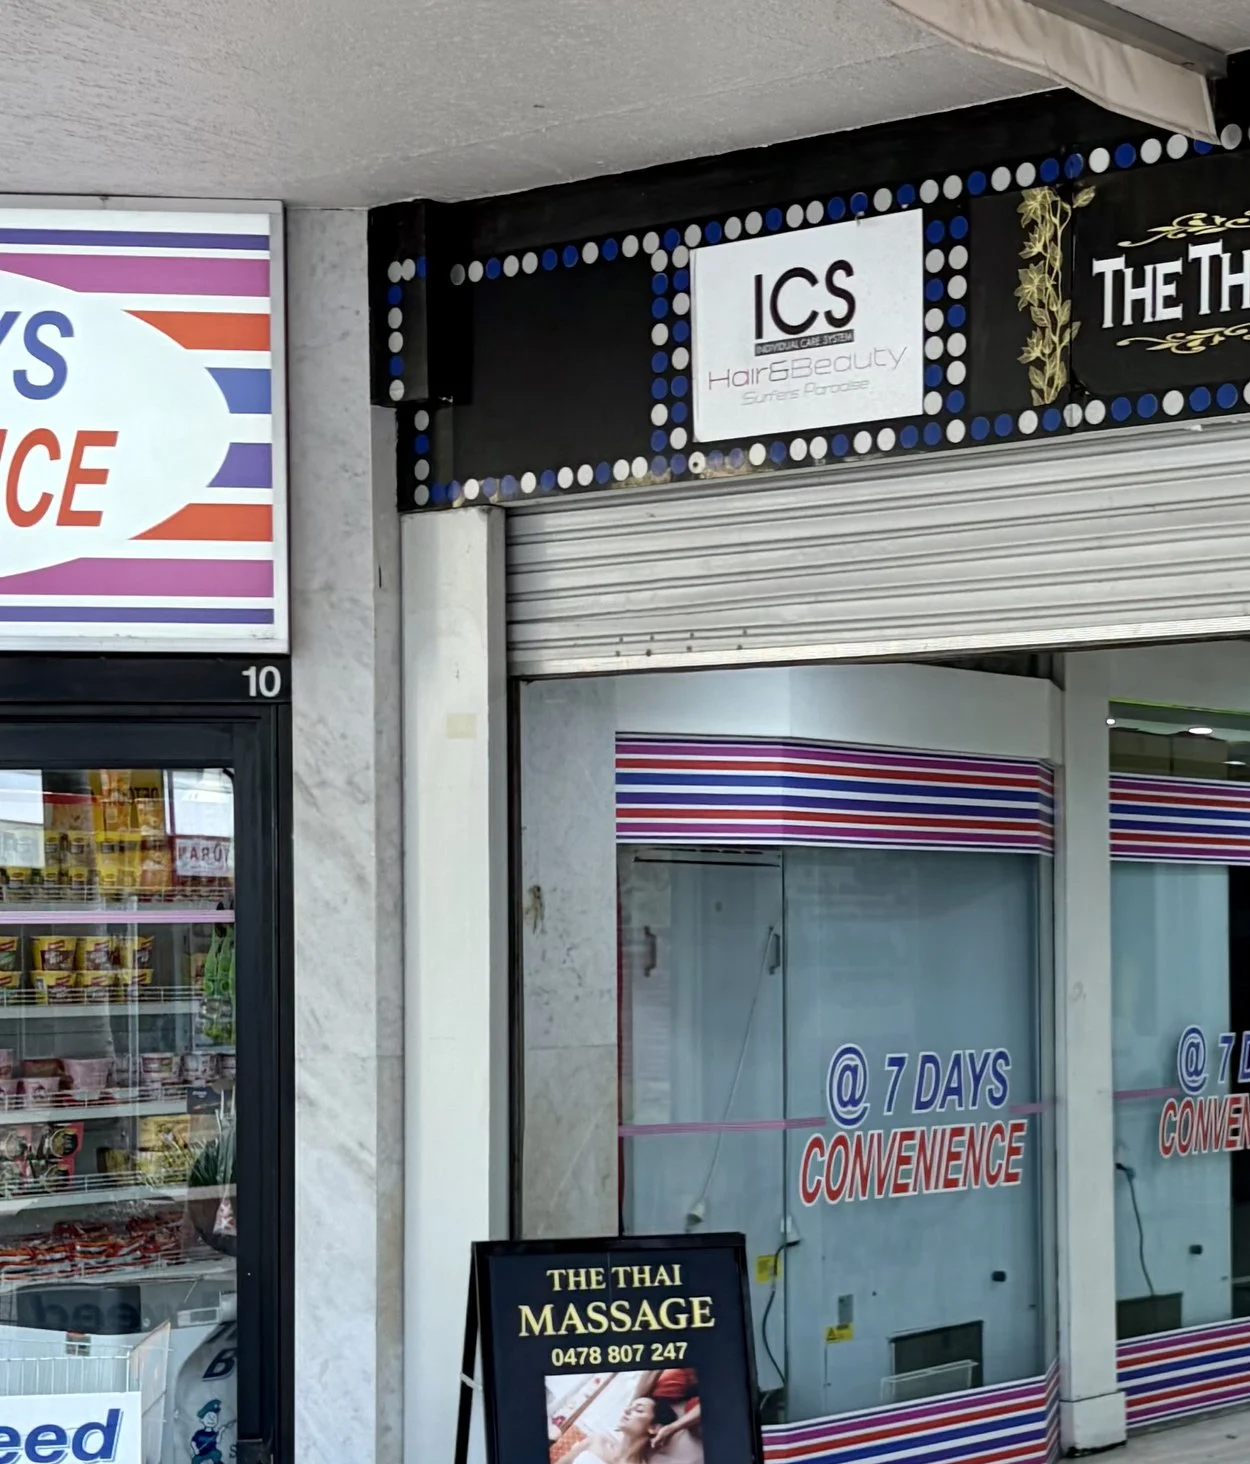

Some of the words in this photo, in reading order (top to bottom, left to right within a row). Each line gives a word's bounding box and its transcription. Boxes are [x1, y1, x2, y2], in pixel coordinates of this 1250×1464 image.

[754, 259, 856, 340] ICS
[756, 341, 798, 355] INDIVIDUAL
[800, 338, 820, 348] CARE
[823, 332, 853, 345] SYSTEM
[741, 388, 800, 406] Surfers
[804, 380, 871, 395] Paradise
[0, 427, 120, 528] CE
[242, 666, 281, 698] 10
[1177, 1024, 1209, 1095] @
[1217, 1032, 1236, 1084] 7
[827, 1043, 870, 1129] @
[883, 1053, 909, 1116] 7
[912, 1048, 1012, 1114] DAYS
[800, 1119, 1028, 1207] CONVENIENCE
[546, 1266, 607, 1292] THE
[611, 1264, 683, 1289] THAI
[518, 1296, 715, 1338] MASSAGE
[551, 1346, 602, 1367] 0478
[608, 1344, 644, 1364] 807
[651, 1341, 688, 1362] 247
